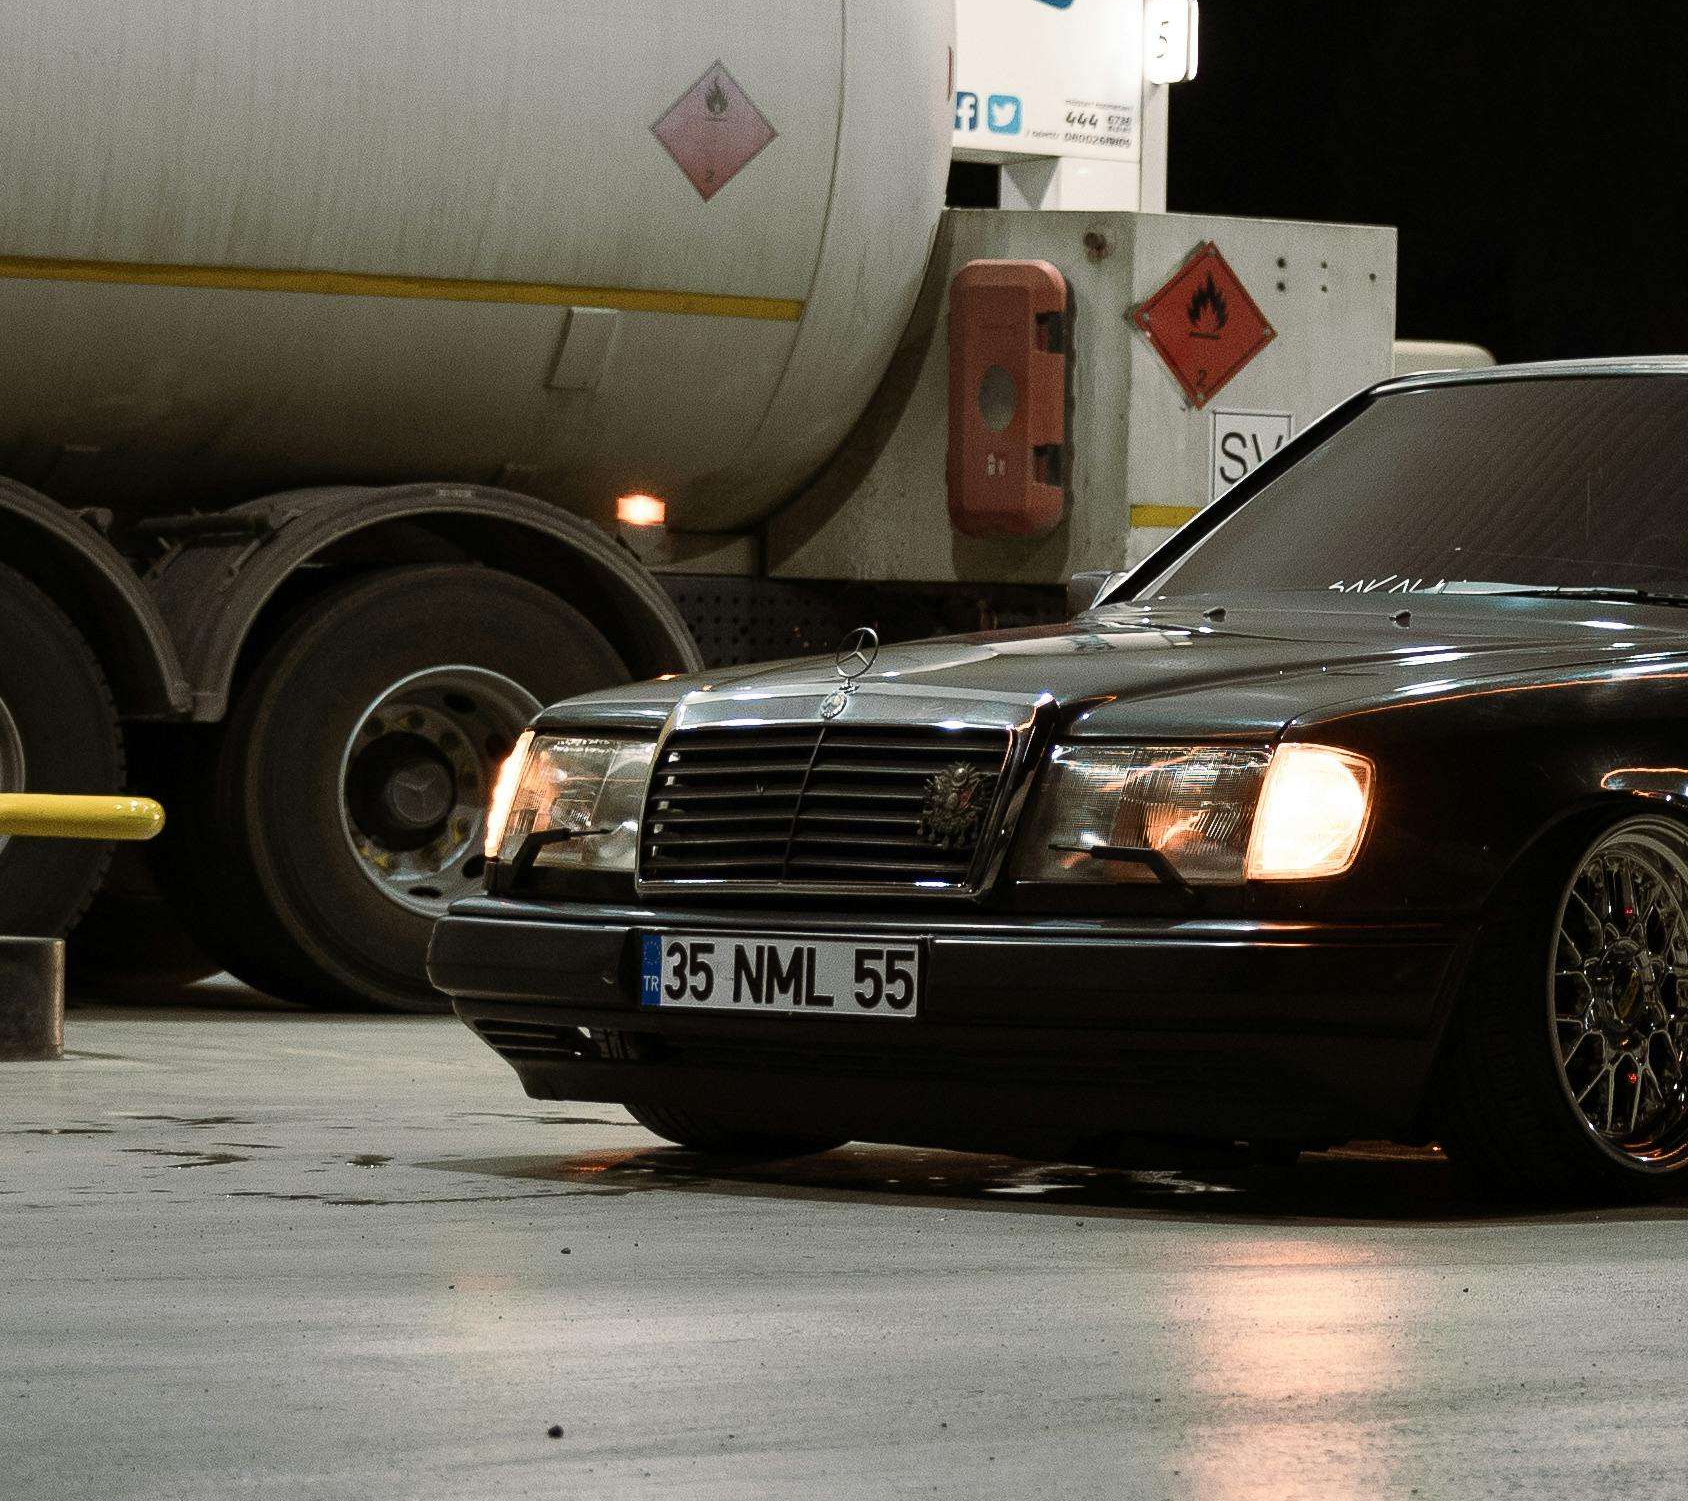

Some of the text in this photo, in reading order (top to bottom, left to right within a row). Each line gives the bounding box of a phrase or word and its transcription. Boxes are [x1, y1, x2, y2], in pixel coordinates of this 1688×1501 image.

[643, 975, 659, 993] TR
[665, 941, 916, 1010] 35 NML 55
